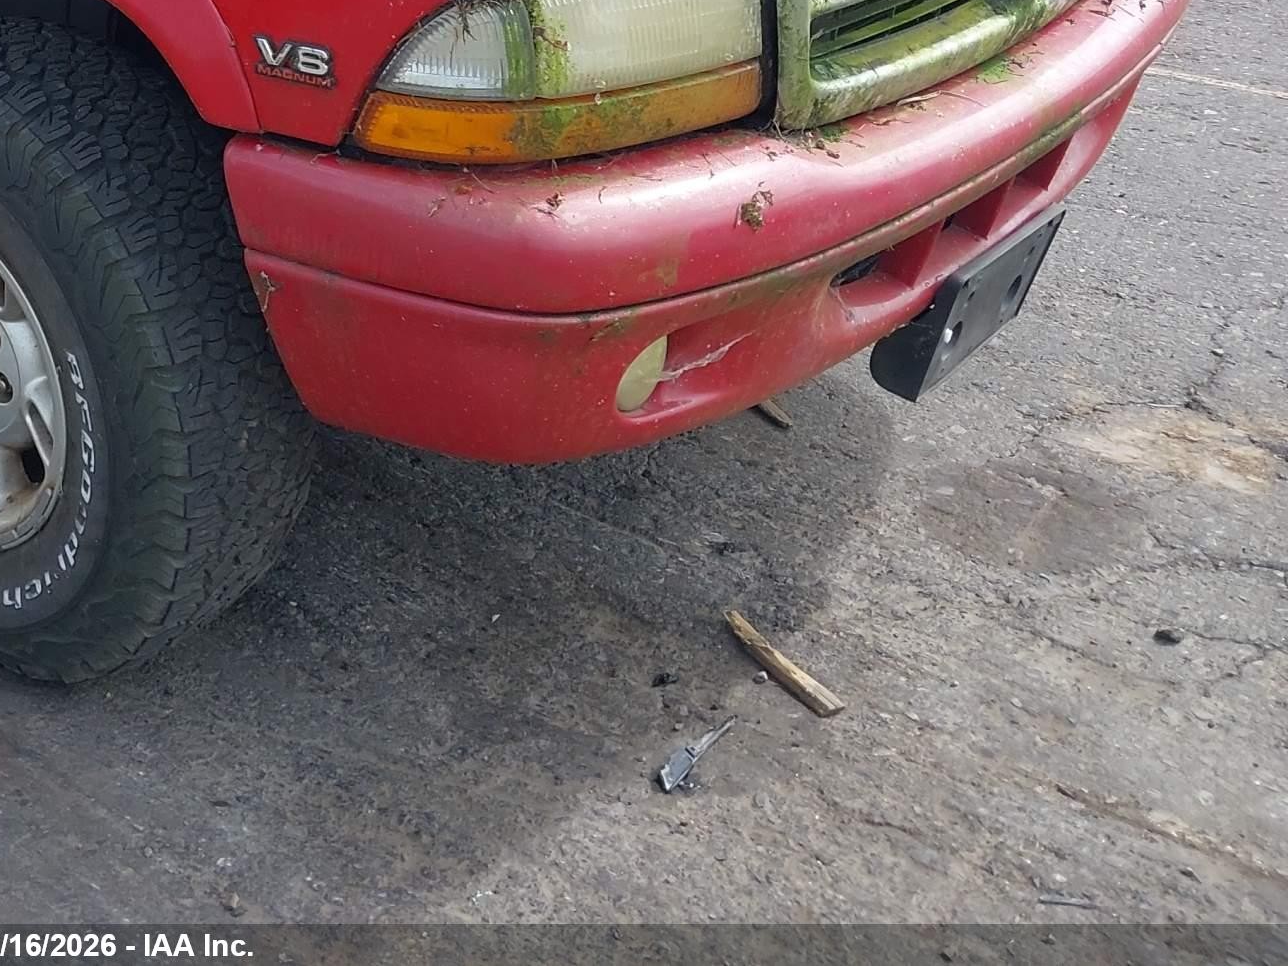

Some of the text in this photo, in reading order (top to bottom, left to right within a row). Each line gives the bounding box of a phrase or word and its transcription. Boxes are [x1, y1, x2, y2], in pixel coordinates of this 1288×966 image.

[256, 37, 329, 75] V8
[257, 65, 332, 87] MAGNUM
[2, 350, 95, 609] BFGoodich
